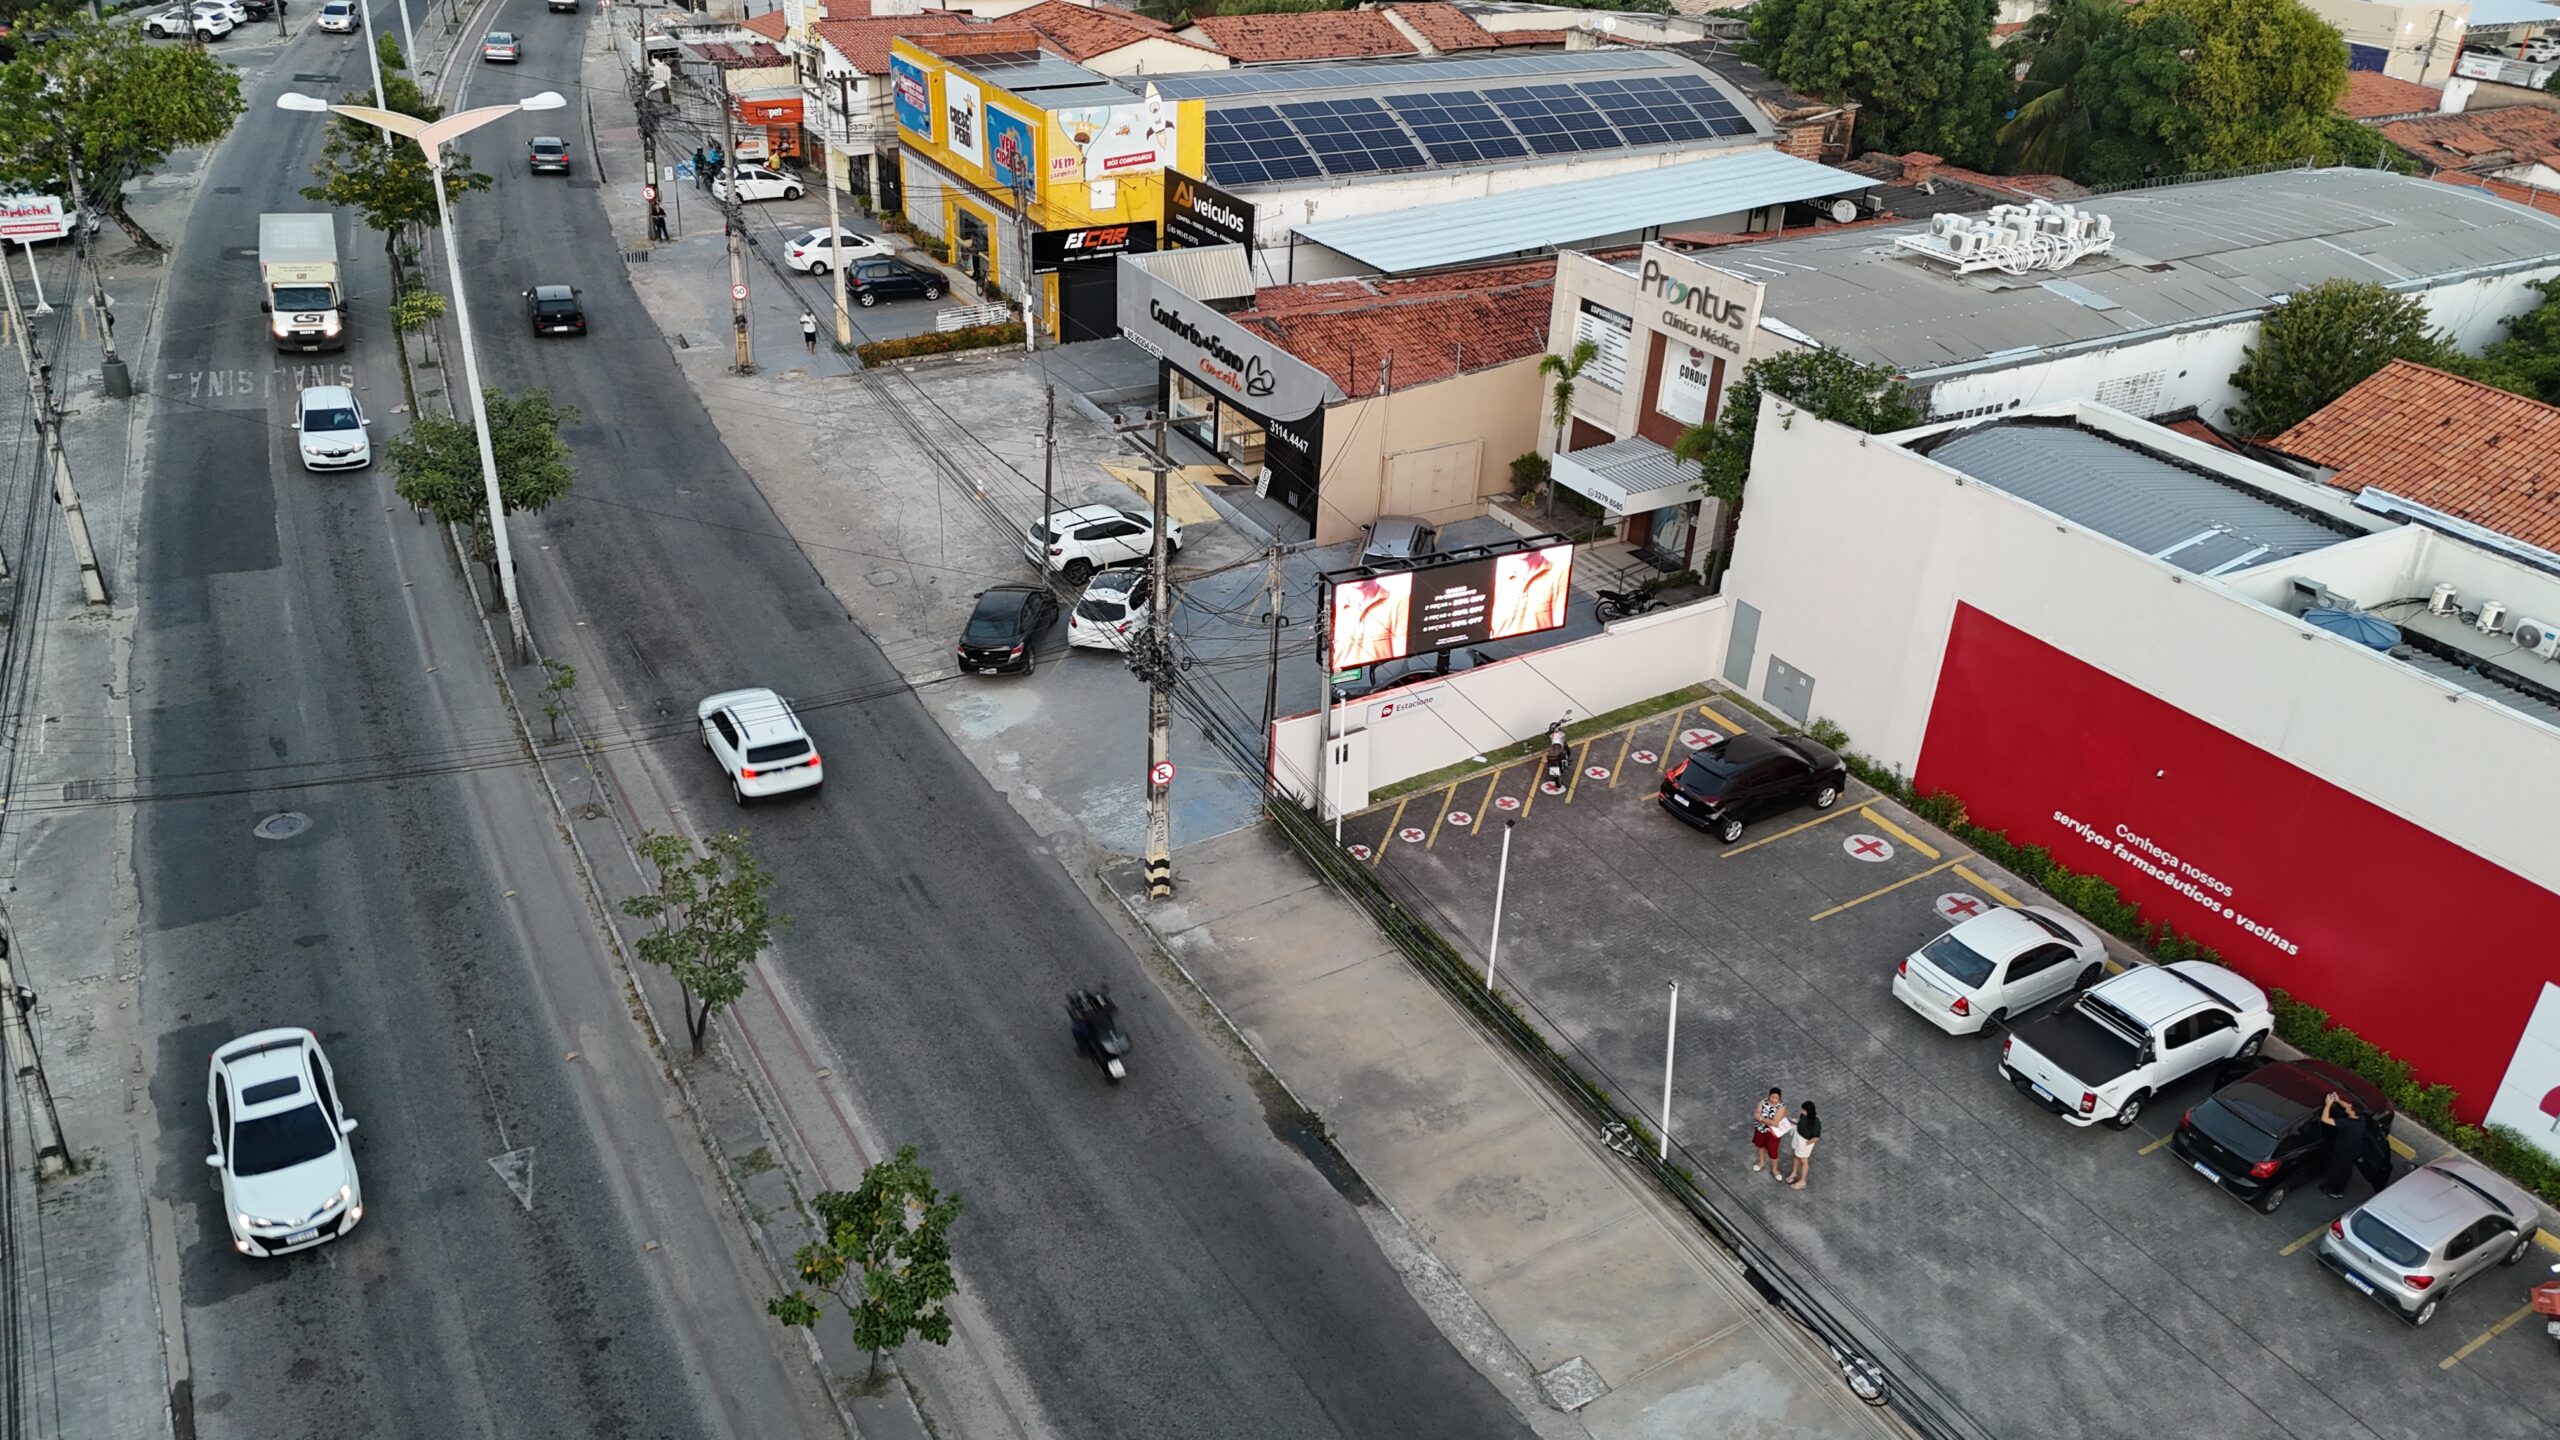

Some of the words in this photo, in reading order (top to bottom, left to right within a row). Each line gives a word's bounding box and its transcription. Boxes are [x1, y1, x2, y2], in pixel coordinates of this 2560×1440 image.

[1000, 133, 1016, 152] VEM
[1051, 157, 1075, 169] VEM
[1106, 159, 1118, 167] NÓS
[1119, 154, 1153, 165] COMPRAMOS
[1193, 197, 1244, 232] veículos
[3, 224, 58, 234] ESTACIONAMENTO
[1641, 259, 1747, 330] Prontus
[1150, 298, 1202, 348] Conforto
[1211, 335, 1244, 372] Sono
[1662, 310, 1698, 336] Clínica
[1700, 325, 1740, 354] Médica
[1680, 364, 1707, 387] CORDIS
[1269, 420, 1309, 453] 3114.4447
[1470, 594, 1486, 603] OFF
[1469, 605, 1485, 613] OFF
[1468, 616, 1484, 624] OFF
[1396, 697, 1434, 712] Estacione
[1158, 766, 1167, 780] E
[2115, 823, 2179, 868] Conheça
[2180, 861, 2233, 897] nossos
[2052, 809, 2112, 851] serviços
[2113, 842, 2222, 913] farmacêuticos
[2222, 907, 2235, 920] e
[2235, 913, 2299, 956] vacinas
